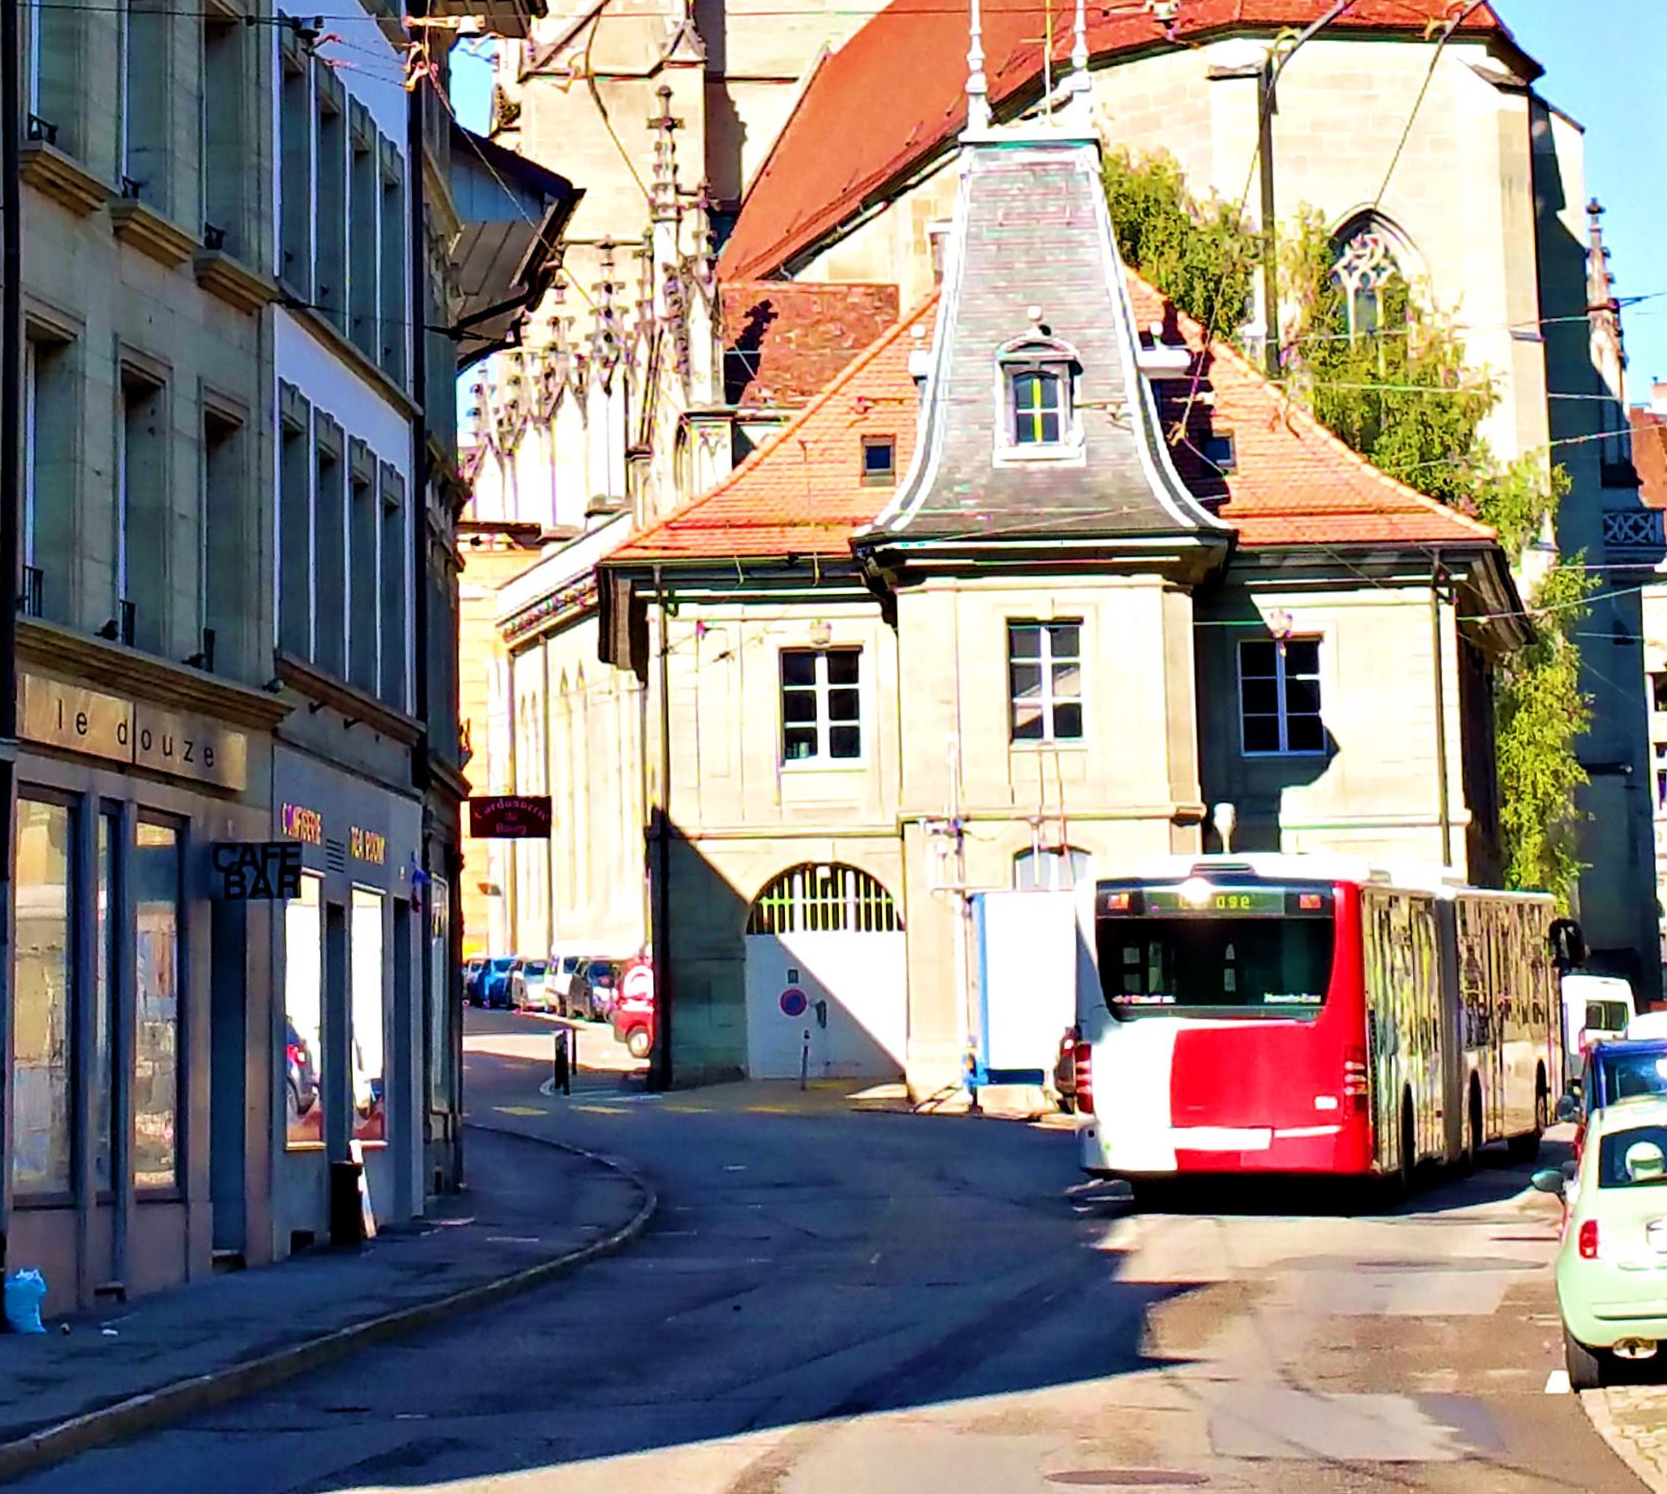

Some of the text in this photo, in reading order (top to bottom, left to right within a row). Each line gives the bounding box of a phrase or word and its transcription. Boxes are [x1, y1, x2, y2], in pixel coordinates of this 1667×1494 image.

[57, 697, 215, 768] le douze
[223, 867, 301, 899] BAR
